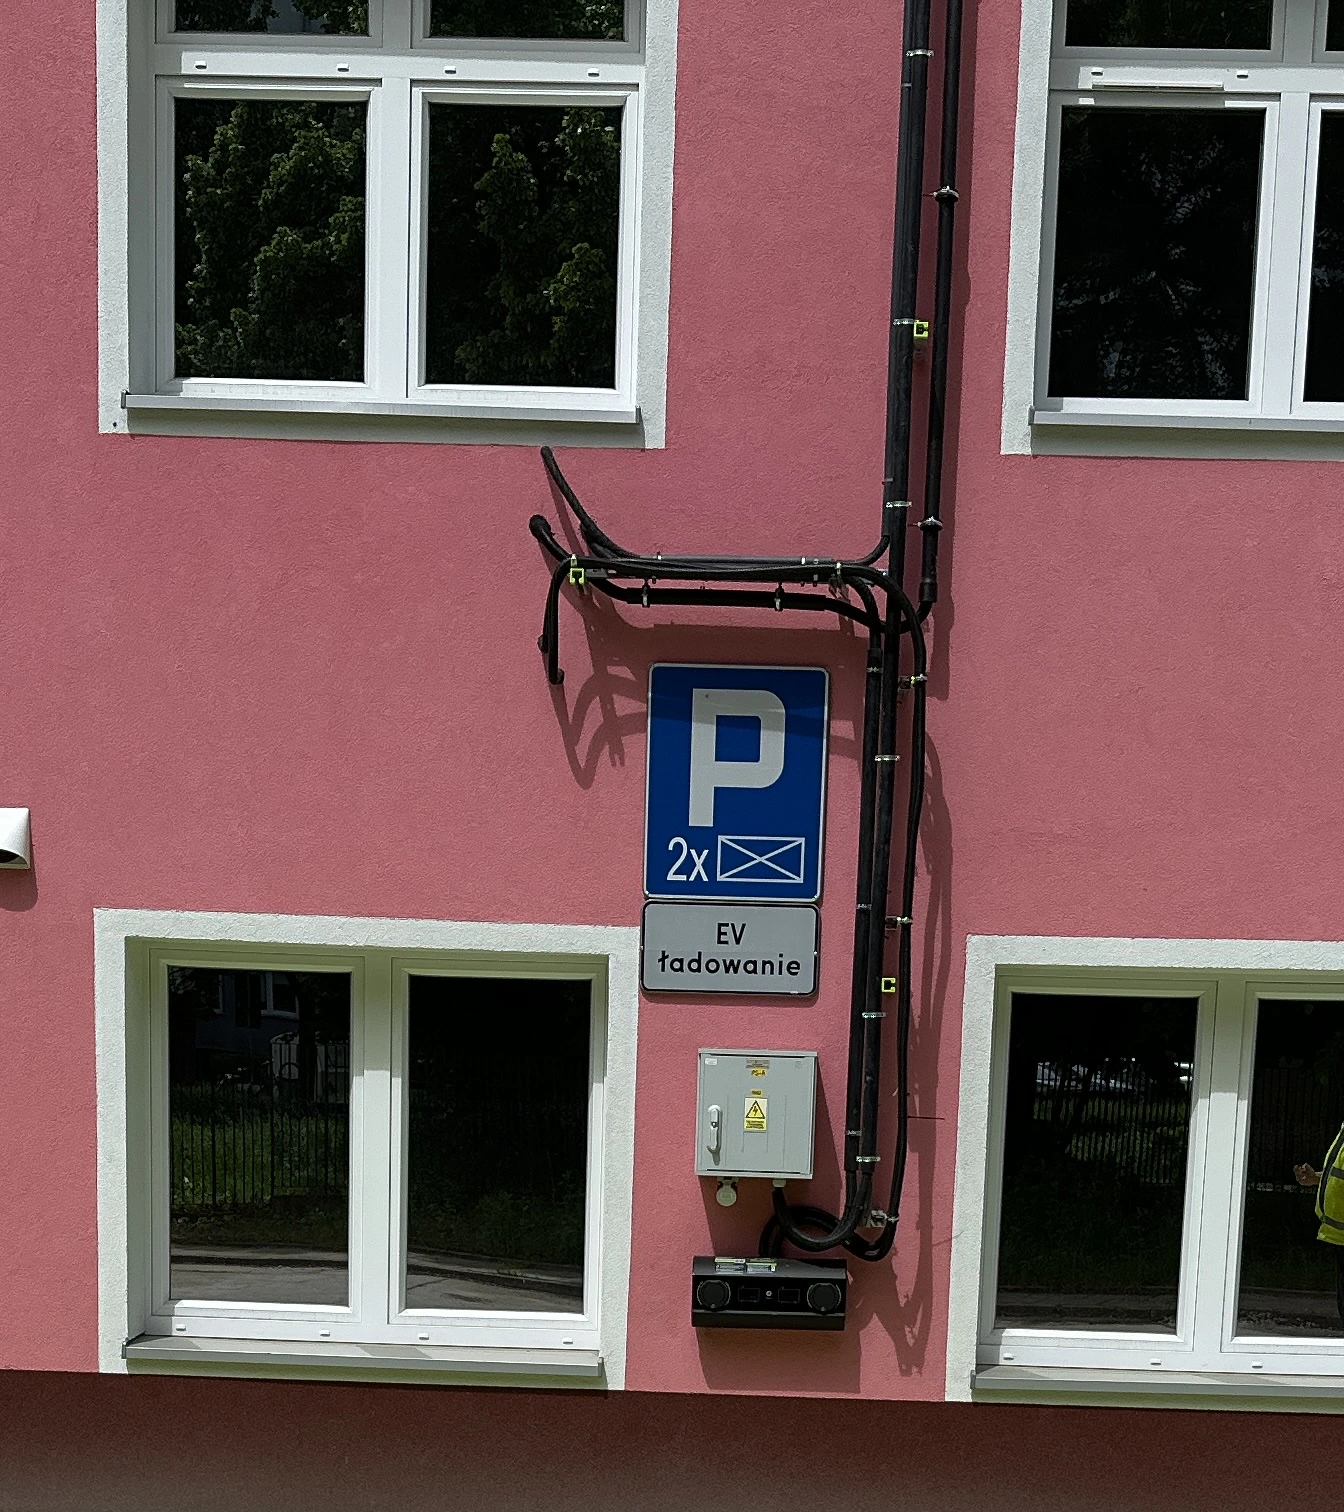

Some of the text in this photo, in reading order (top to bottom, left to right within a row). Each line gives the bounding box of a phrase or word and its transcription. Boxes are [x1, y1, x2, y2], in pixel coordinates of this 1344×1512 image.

[688, 687, 786, 827] P
[666, 836, 709, 881] 2x
[716, 922, 746, 945] EV
[657, 950, 801, 977] ładowanie
